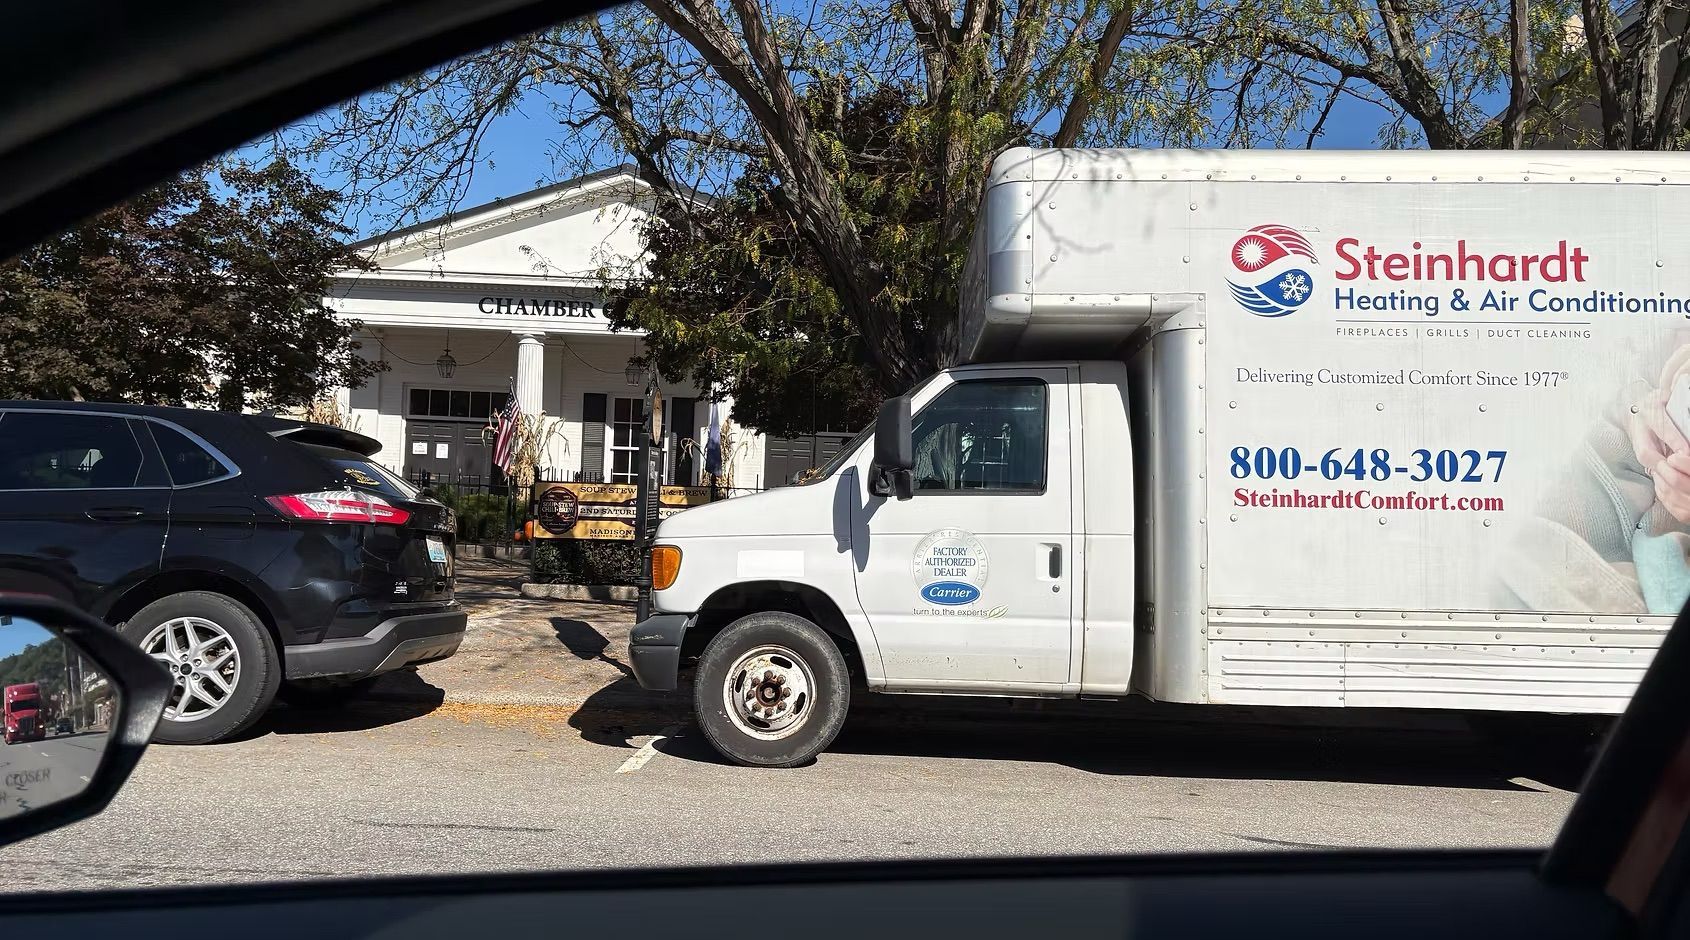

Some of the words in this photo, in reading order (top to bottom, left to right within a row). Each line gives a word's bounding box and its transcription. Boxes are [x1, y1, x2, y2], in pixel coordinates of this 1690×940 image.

[1335, 238, 1589, 282] Steinhardt
[478, 296, 596, 319] CHAMBER
[1335, 287, 1439, 316] Heating
[1450, 288, 1470, 311] &
[1479, 289, 1519, 311] Air
[1336, 327, 1408, 337] FIREPLACES
[1426, 328, 1469, 338] GRILLS
[1487, 329, 1521, 338] DUCT
[1527, 329, 1591, 339] CLEANING
[1236, 367, 1314, 386] Delivering
[1317, 367, 1404, 385] Customized
[1408, 369, 1472, 386] Comfort
[1476, 370, 1518, 386] Since
[1230, 446, 1508, 483] 800-648-3027
[580, 486, 606, 494] SOUP
[678, 489, 708, 497] BREW
[1233, 487, 1504, 511] SteinhardtComfort.com
[601, 508, 637, 516] SATUR
[933, 547, 968, 556] FACTORY
[925, 557, 976, 566] AUTHORIZED
[934, 567, 967, 576] DEALER
[929, 586, 972, 598] Carrier
[957, 609, 988, 617] experts
